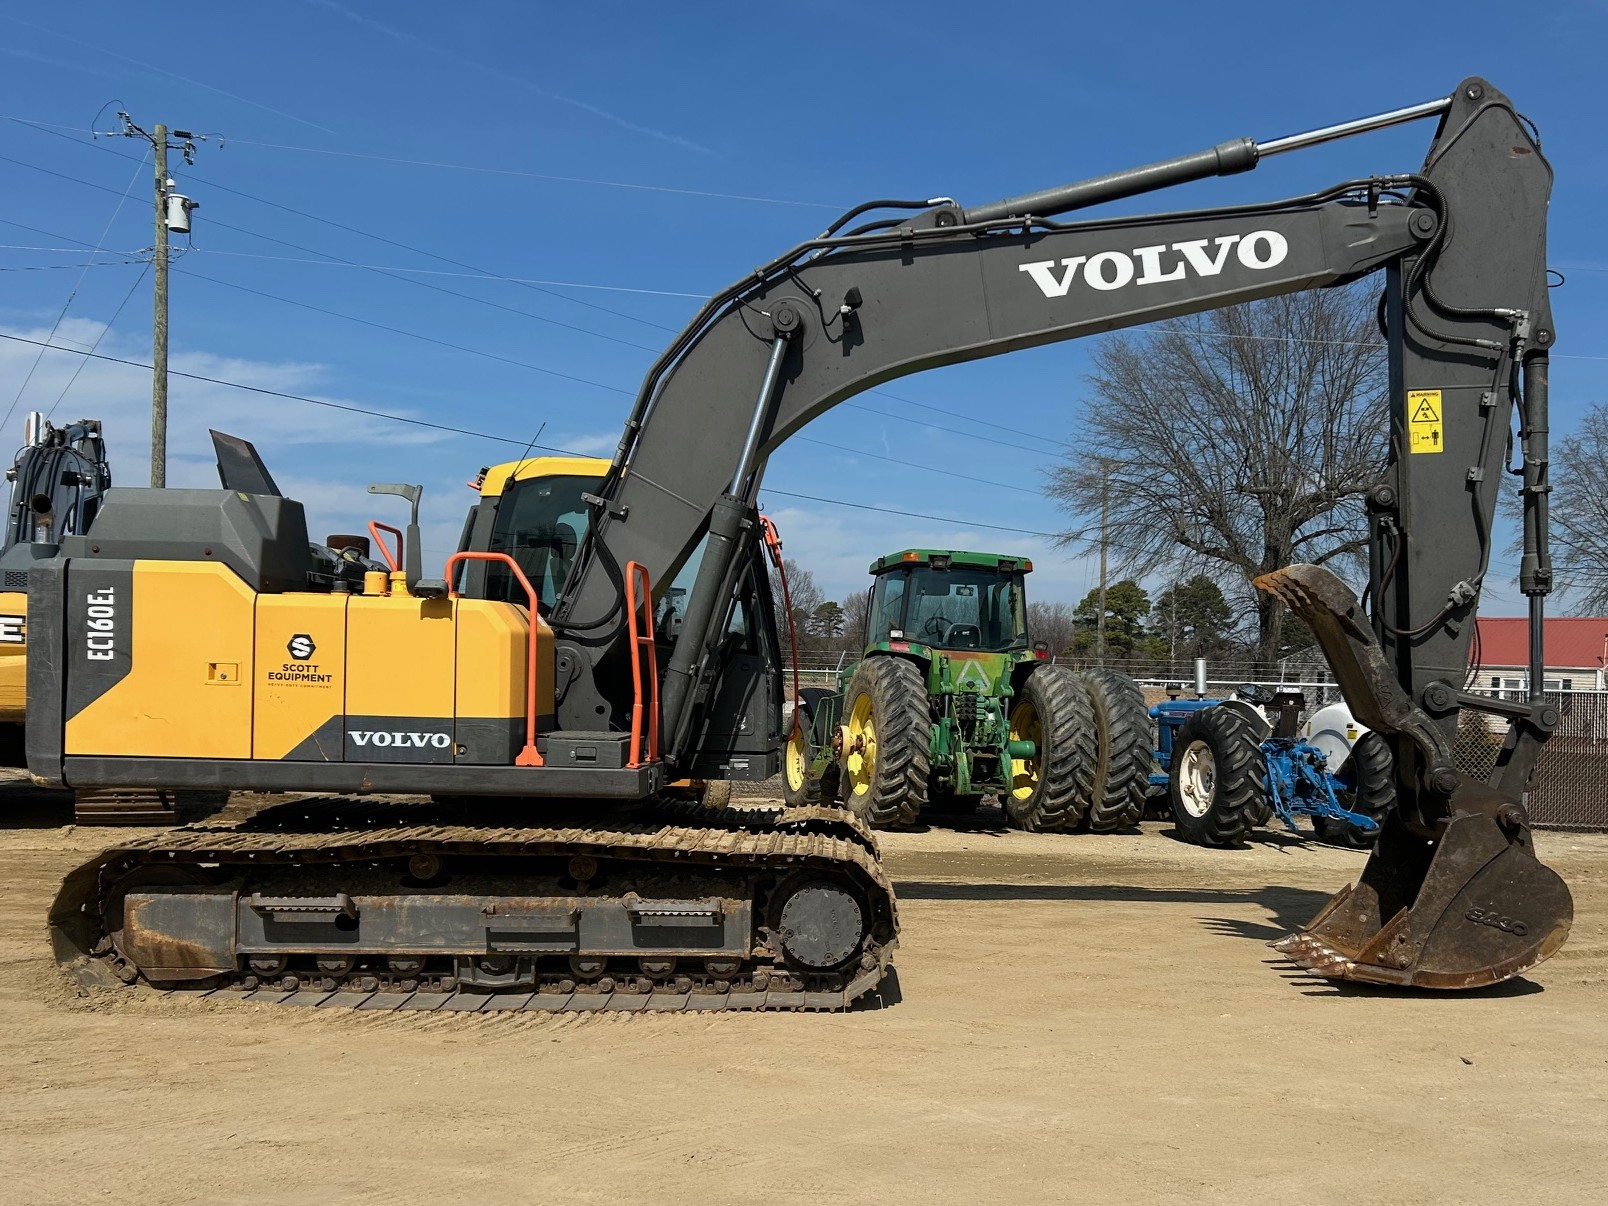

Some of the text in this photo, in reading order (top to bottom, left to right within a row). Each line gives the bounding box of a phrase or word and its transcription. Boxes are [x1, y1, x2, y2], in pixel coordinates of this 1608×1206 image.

[1019, 230, 1288, 298] VOLVO
[87, 586, 114, 660] EC160EL
[268, 672, 332, 682] EQUIPMENT
[282, 664, 319, 673] SCOTT
[348, 731, 451, 748] VOLVO
